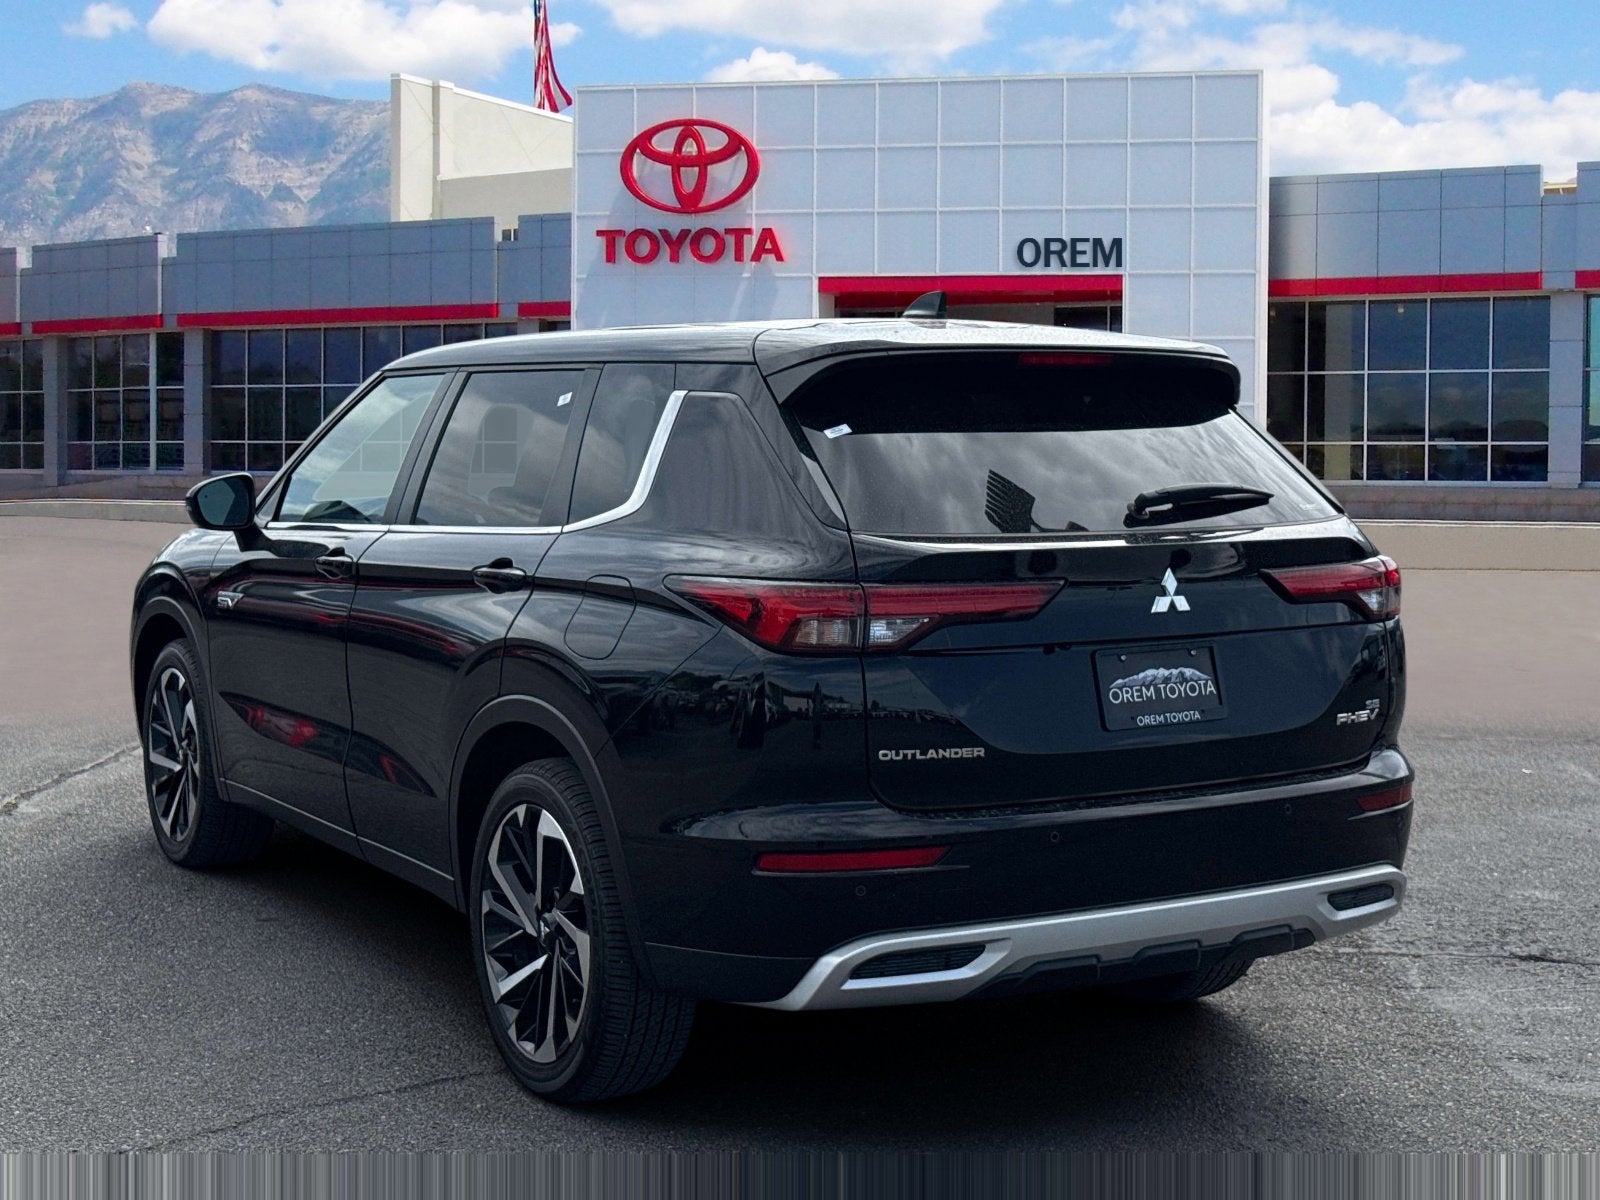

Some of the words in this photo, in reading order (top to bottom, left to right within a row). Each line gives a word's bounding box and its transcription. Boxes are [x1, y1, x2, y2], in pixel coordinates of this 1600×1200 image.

[596, 227, 785, 264] TOYOTA
[1017, 237, 1123, 268] OREM
[1109, 685, 1156, 704] OREM
[1157, 680, 1217, 700] TOYOTA
[1136, 713, 1165, 727] OREM
[1165, 710, 1201, 723] TOYOTA
[1336, 708, 1380, 725] PHEV
[878, 747, 985, 760] OUTLANDER
